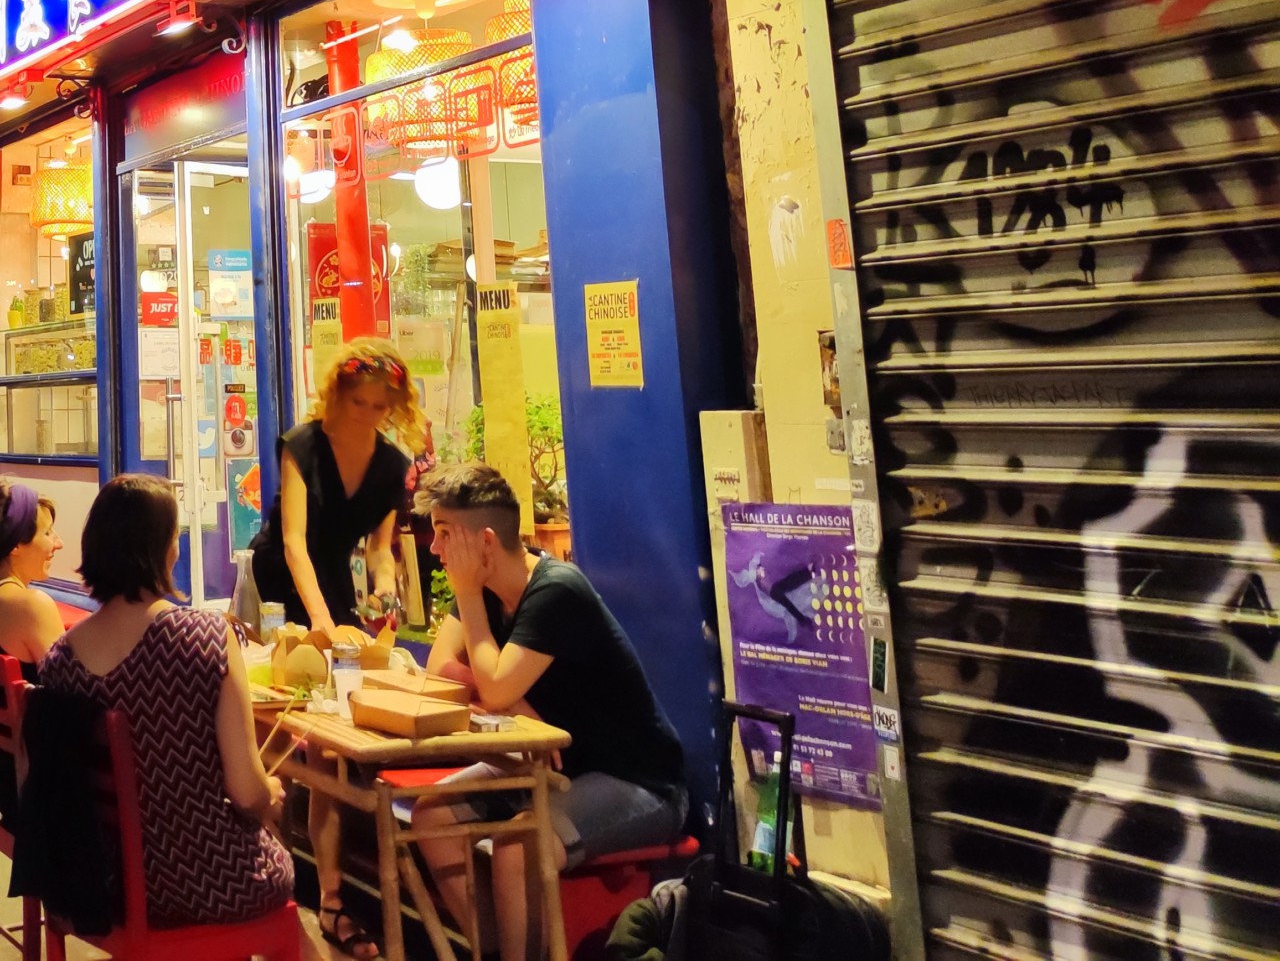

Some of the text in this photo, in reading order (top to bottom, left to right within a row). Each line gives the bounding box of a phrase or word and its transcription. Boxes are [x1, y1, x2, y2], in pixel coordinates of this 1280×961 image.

[479, 289, 510, 311] MENU
[593, 292, 628, 307] CANTINE
[149, 302, 172, 314] JUST
[313, 302, 337, 321] MENU
[589, 306, 629, 320] CHINOISE
[414, 350, 441, 360] 2019
[730, 512, 851, 527] LE HALL DE LA CHANSON
[812, 659, 828, 668] VIAN
